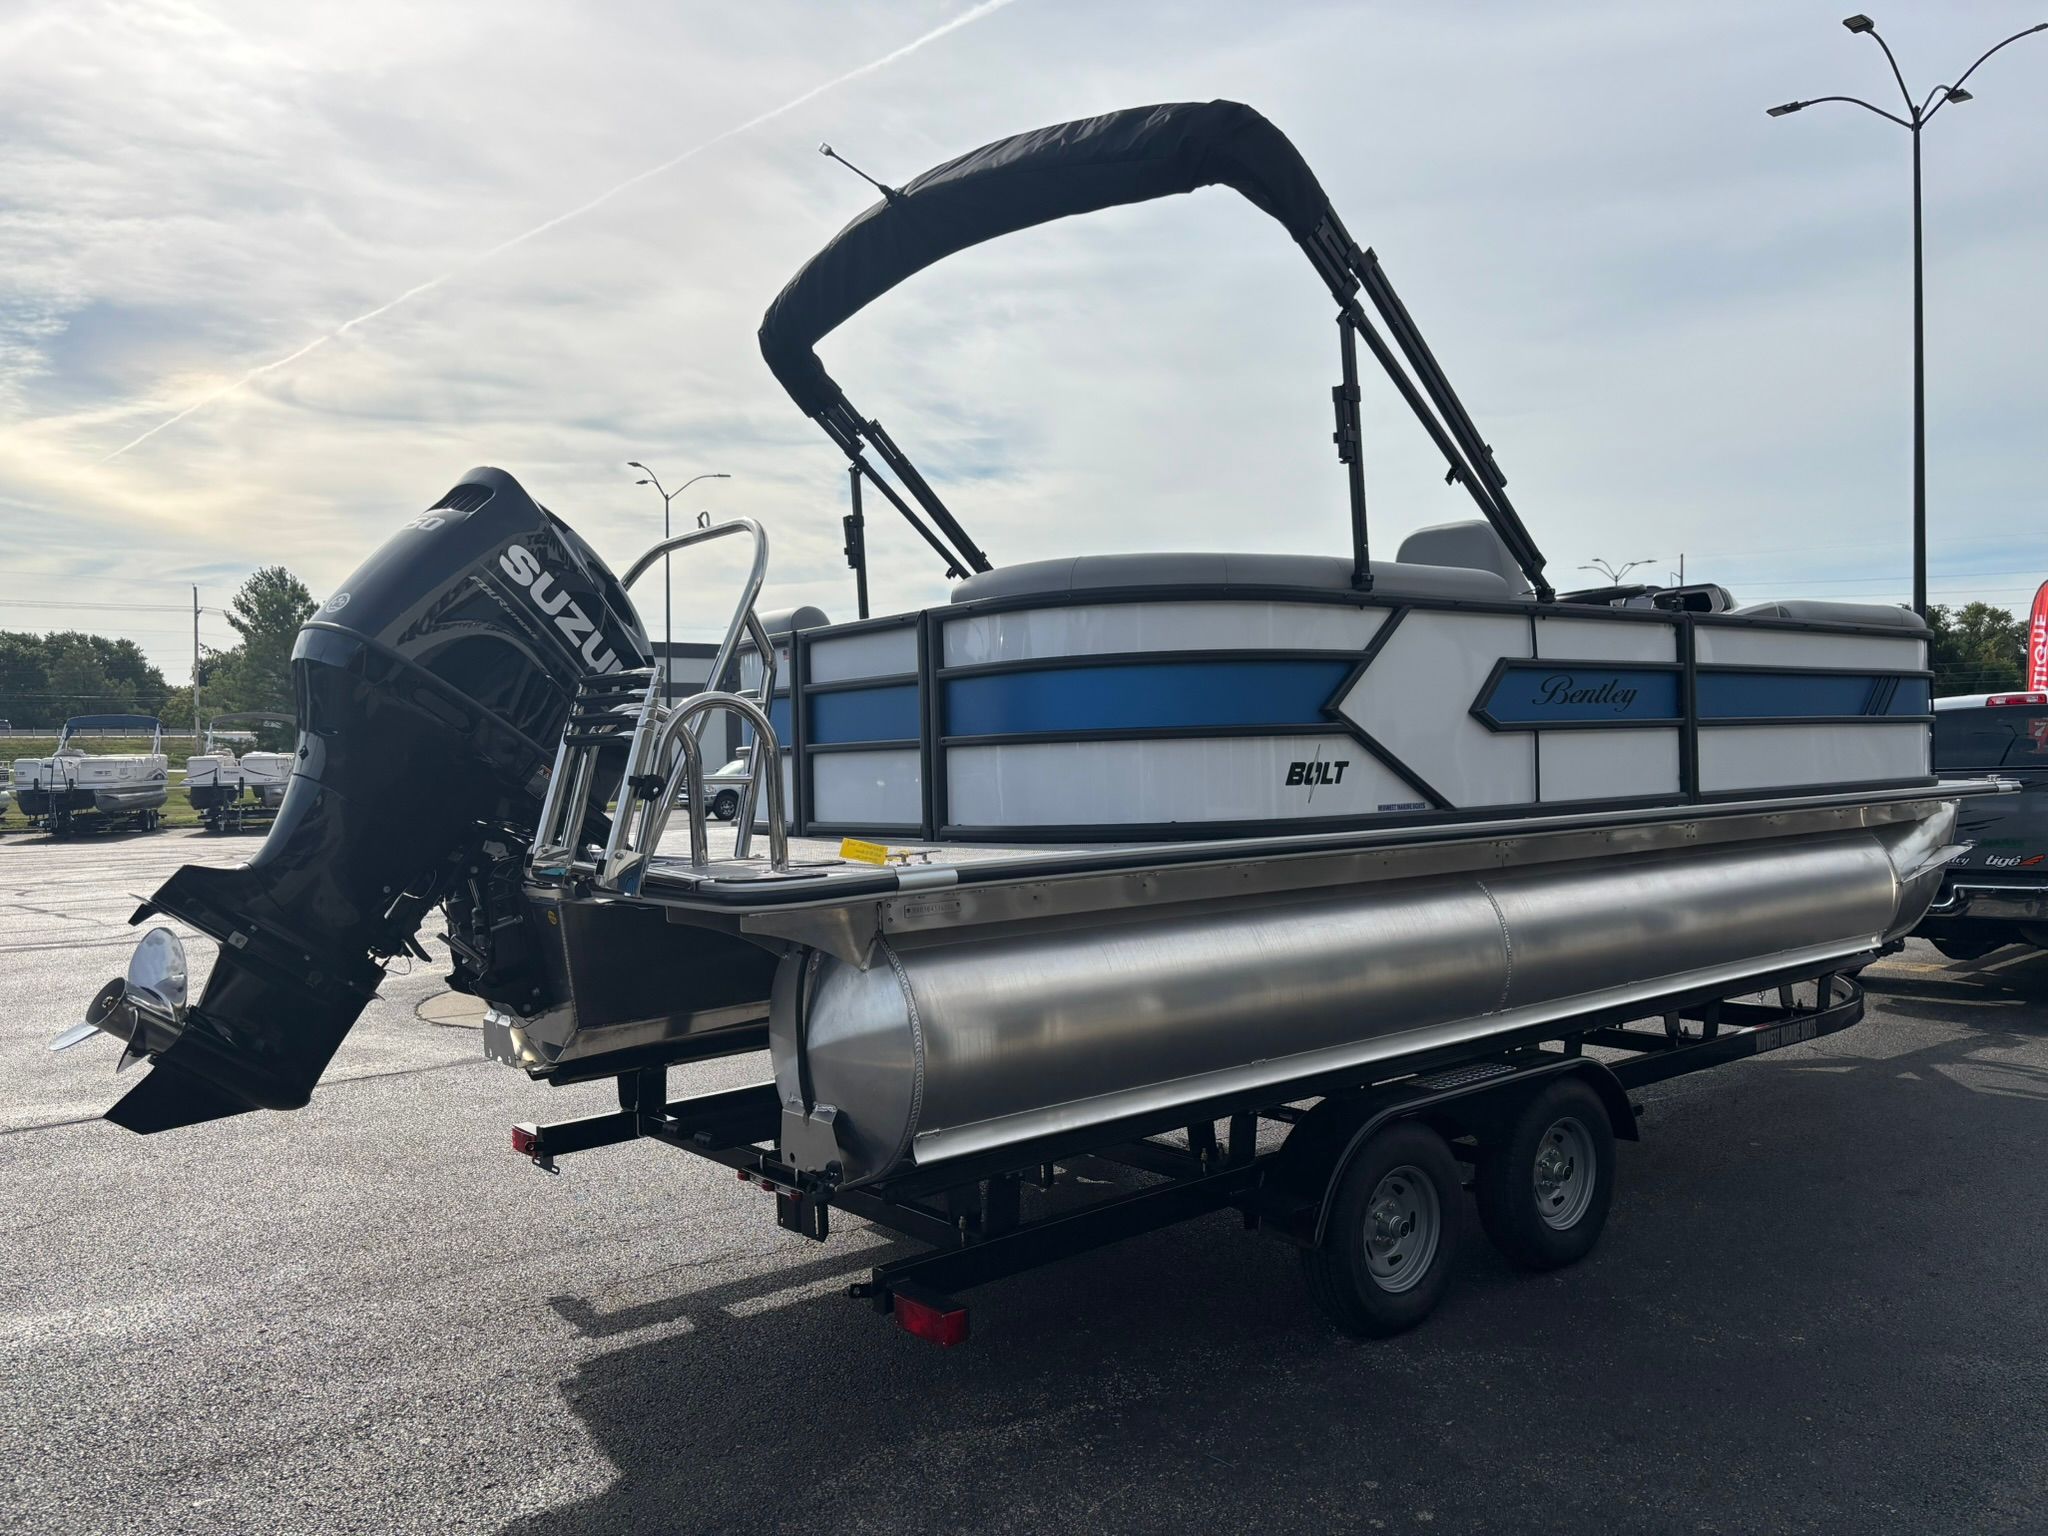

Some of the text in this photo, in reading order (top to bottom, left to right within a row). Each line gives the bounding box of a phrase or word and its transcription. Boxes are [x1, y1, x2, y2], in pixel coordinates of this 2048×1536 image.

[499, 544, 624, 675] SUZU
[1532, 674, 1638, 713] Bentley
[1285, 760, 1350, 786] BOLT
